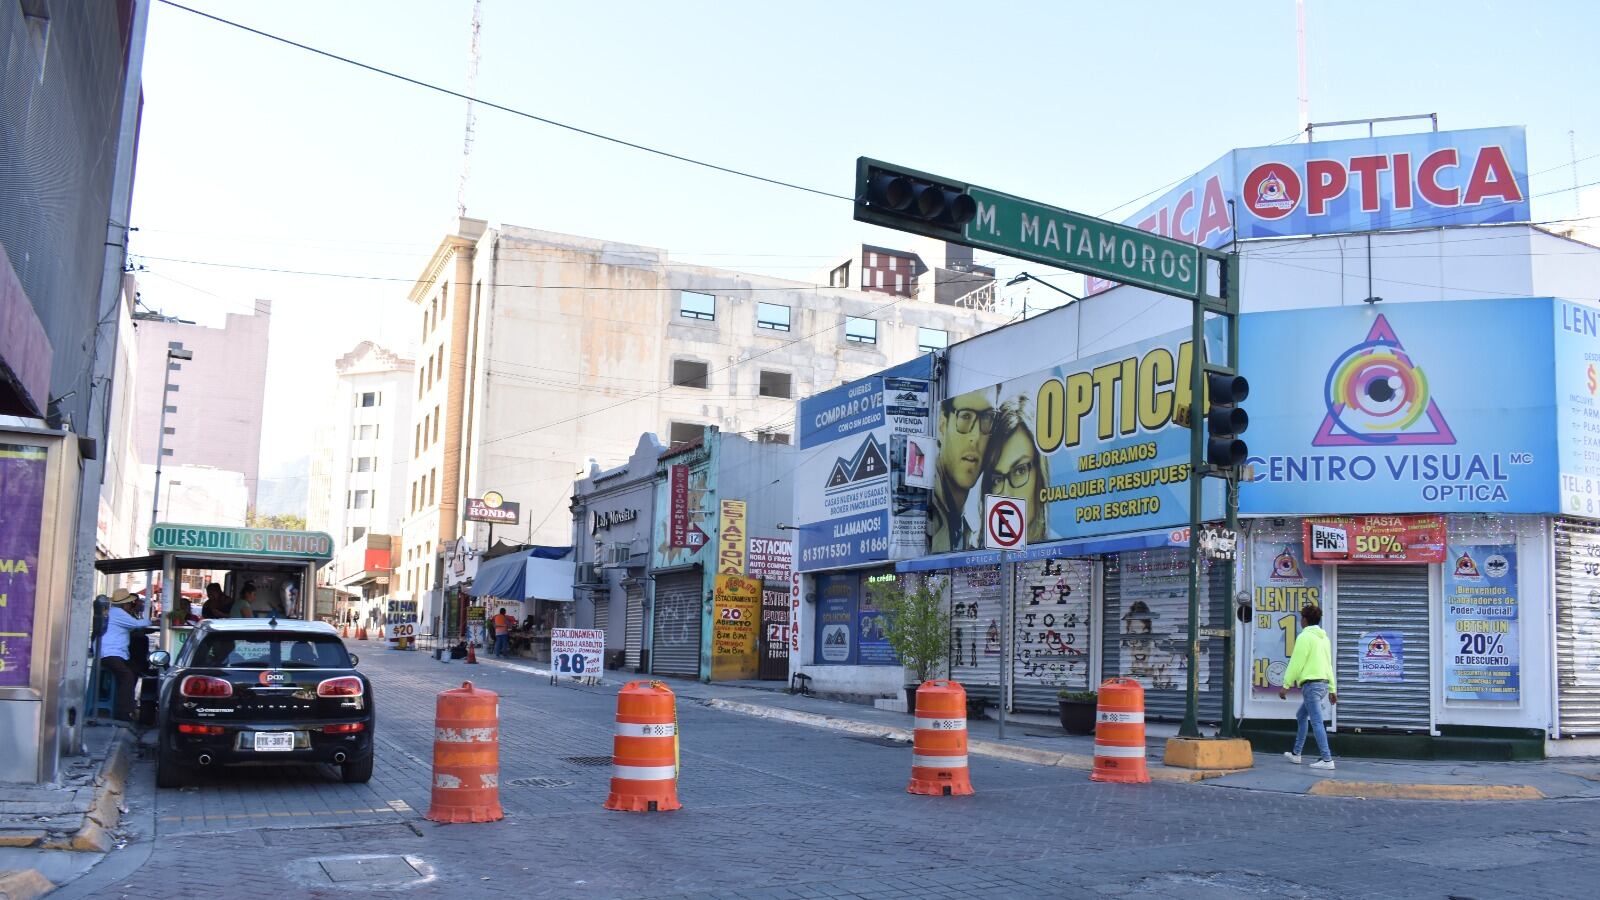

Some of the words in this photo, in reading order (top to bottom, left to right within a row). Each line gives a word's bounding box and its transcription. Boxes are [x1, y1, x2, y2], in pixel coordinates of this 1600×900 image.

[1243, 145, 1524, 219] OPTICA
[975, 200, 1001, 238] M.
[1021, 211, 1192, 283] MATAMOROS
[848, 383, 872, 398] QUIERES
[815, 403, 859, 428] COMPRAR
[861, 400, 869, 412] O
[1078, 442, 1158, 473] MEJORAMOS
[1245, 454, 1377, 482] CENTRO
[1384, 453, 1509, 481] VISUAL
[1510, 452, 1533, 465] MC
[1040, 480, 1107, 504] CUALQUIER
[1421, 483, 1509, 502] OPTICA
[824, 496, 840, 507] CASAS
[830, 503, 848, 515] BROKER
[1076, 505, 1102, 524] POR
[1104, 496, 1160, 520] ESCRITO
[1364, 517, 1402, 527] HASTA
[153, 528, 262, 551] QUESADILLAS
[267, 534, 329, 554] MEXICO
[1315, 532, 1345, 542] BUEN
[966, 555, 993, 564] OPTICA
[997, 550, 1028, 562] CNTRO
[1032, 548, 1063, 558] VISUAL
[1254, 586, 1320, 612] LENTES
[722, 608, 741, 620] 20
[1450, 606, 1475, 615] Poder
[1477, 607, 1513, 616] Judicial!
[1257, 613, 1271, 629] EN
[393, 624, 413, 637] $20
[552, 629, 603, 640] ESTACIONAMIENTO
[552, 640, 574, 648] PUBLICO
[1460, 633, 1504, 656] 20%
[1455, 655, 1465, 665] DE
[1466, 656, 1509, 666] DESCUENTO
[266, 672, 285, 683] pax
